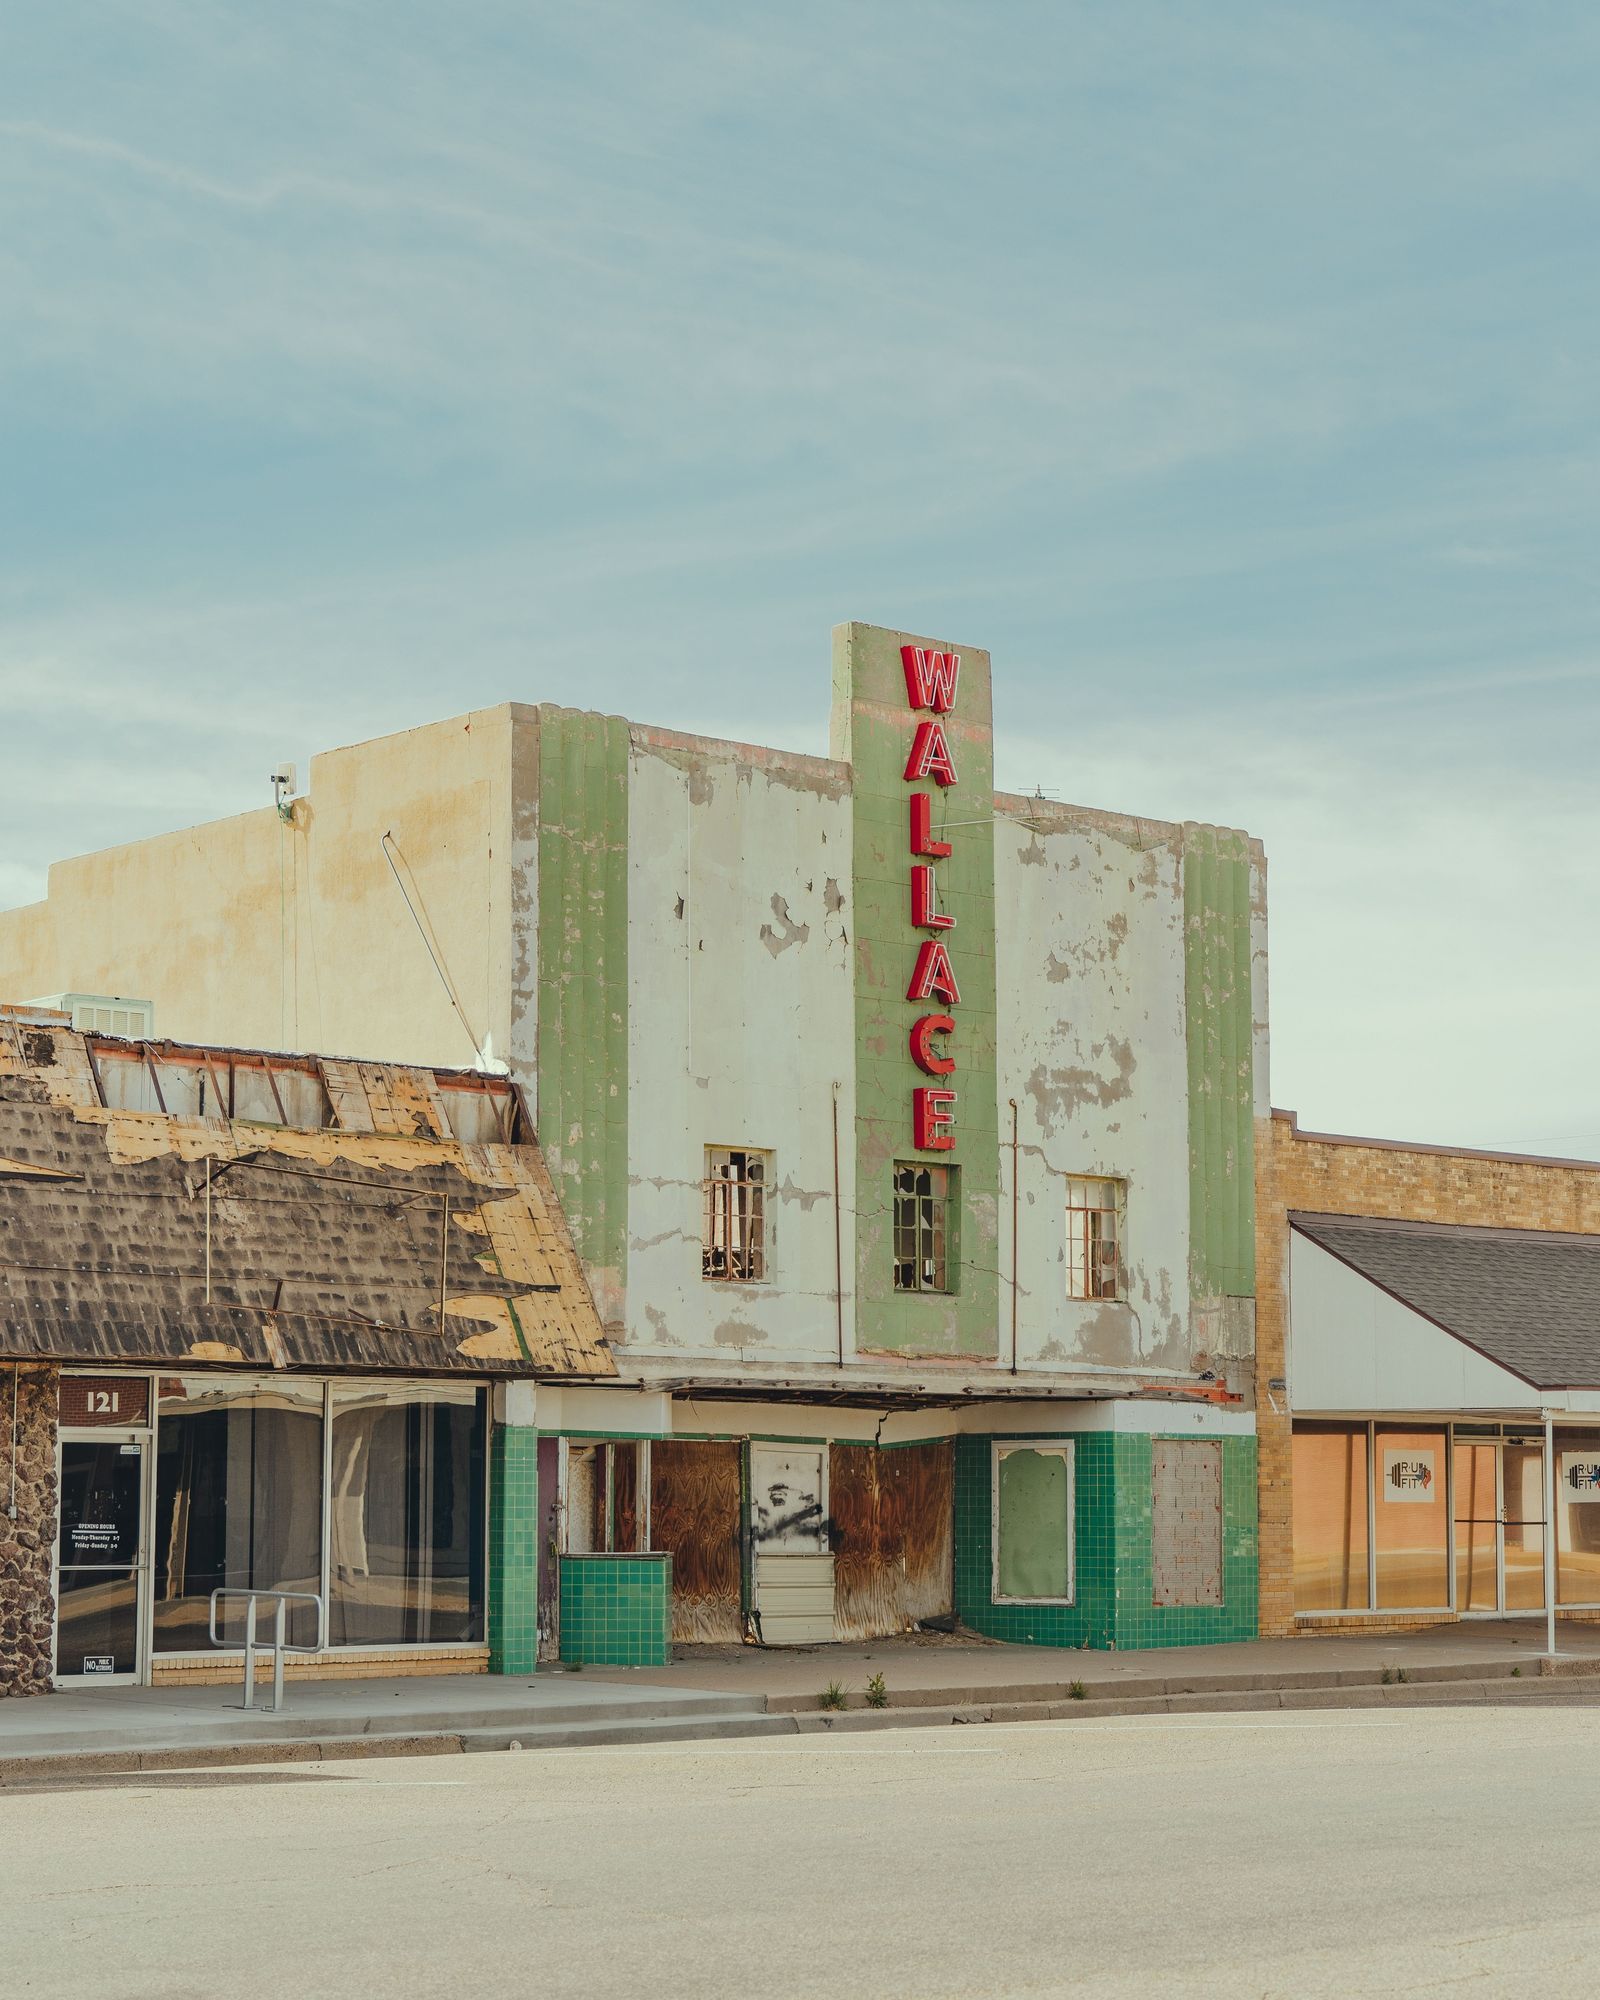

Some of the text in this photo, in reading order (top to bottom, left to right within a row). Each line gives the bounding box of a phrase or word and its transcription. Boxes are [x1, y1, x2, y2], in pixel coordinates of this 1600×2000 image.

[901, 645, 960, 1151] WALLACE
[87, 1391, 119, 1412] 121
[1401, 1478, 1419, 1489] FIT
[1578, 1479, 1594, 1490] FIT
[86, 1660, 95, 1670] NO
